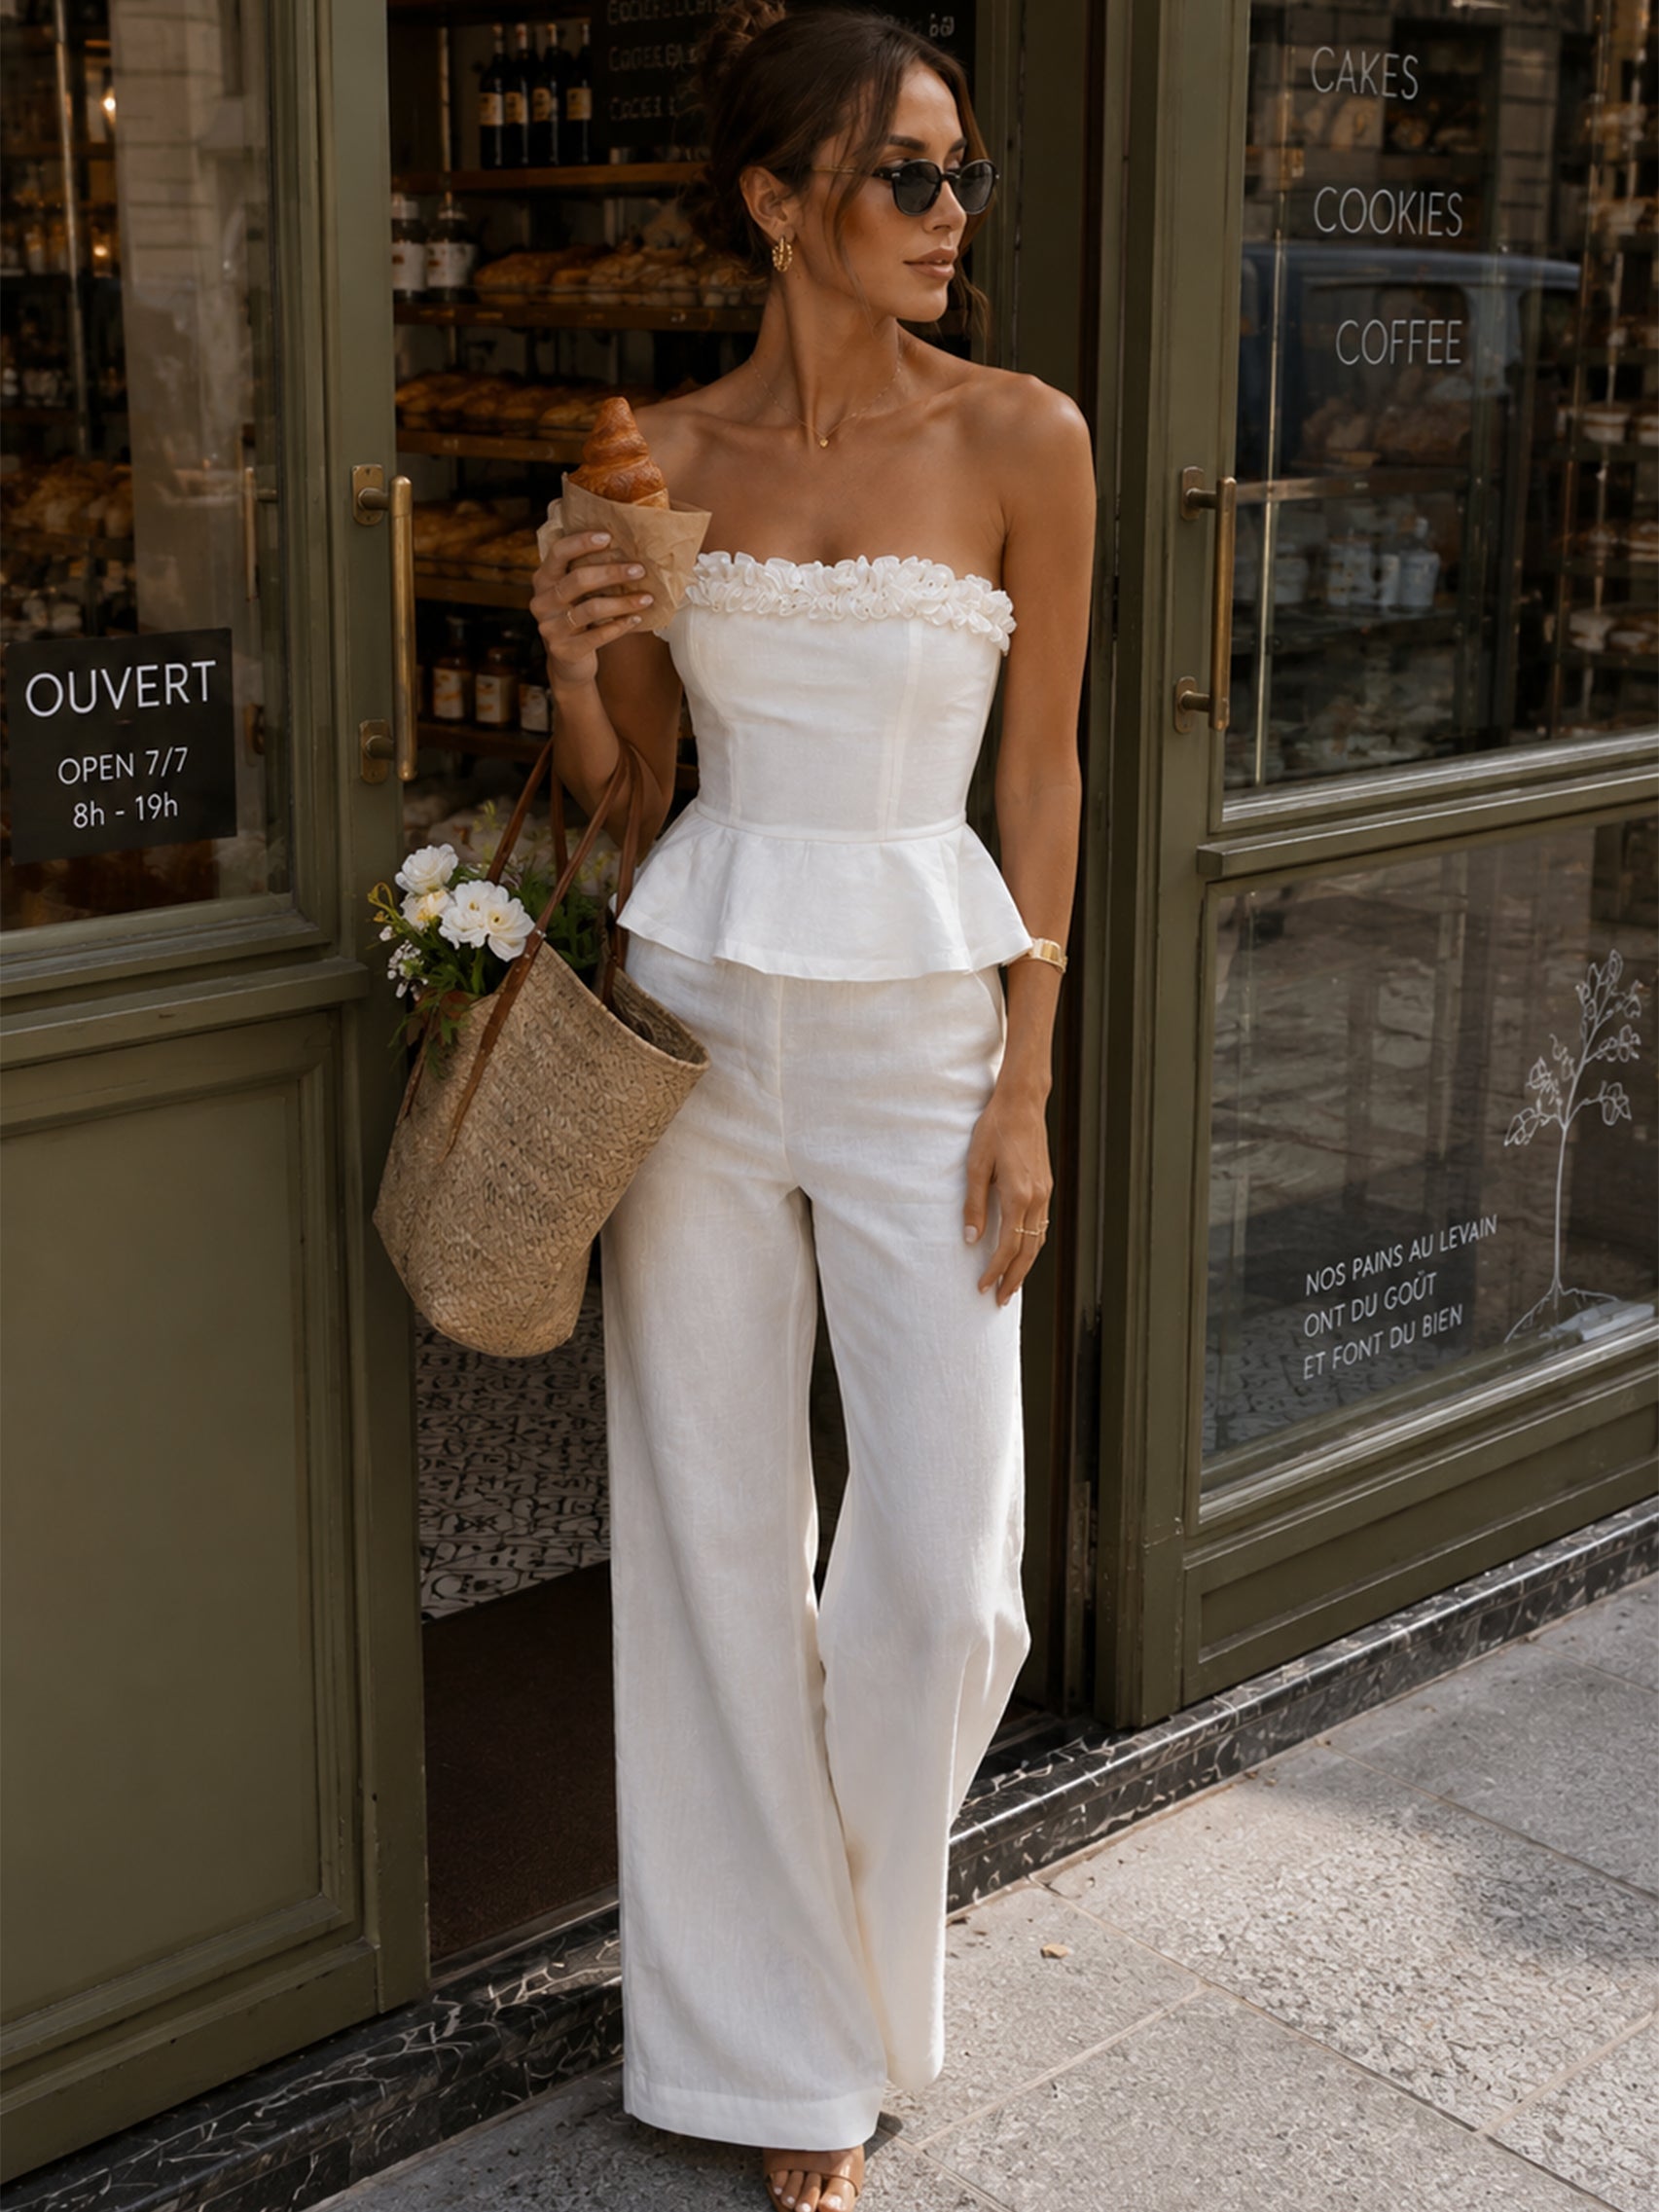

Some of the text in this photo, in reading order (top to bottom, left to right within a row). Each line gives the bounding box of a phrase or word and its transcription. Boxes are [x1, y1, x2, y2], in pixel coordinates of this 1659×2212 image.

[1312, 47, 1418, 99] CAKES
[1315, 187, 1462, 236] COOKIES
[1336, 319, 1461, 365] COFFEE
[25, 660, 216, 717] OUVERT
[58, 747, 188, 784] OPEN 7/7
[73, 801, 104, 828] 8h
[135, 792, 177, 820] 19h
[1306, 1215, 1497, 1295] NOS PAINS AU LEVAIN
[1304, 1303, 1346, 1337] ONT
[1352, 1292, 1378, 1322] DU
[1304, 1304, 1462, 1380] ET FONT DU BIEN
